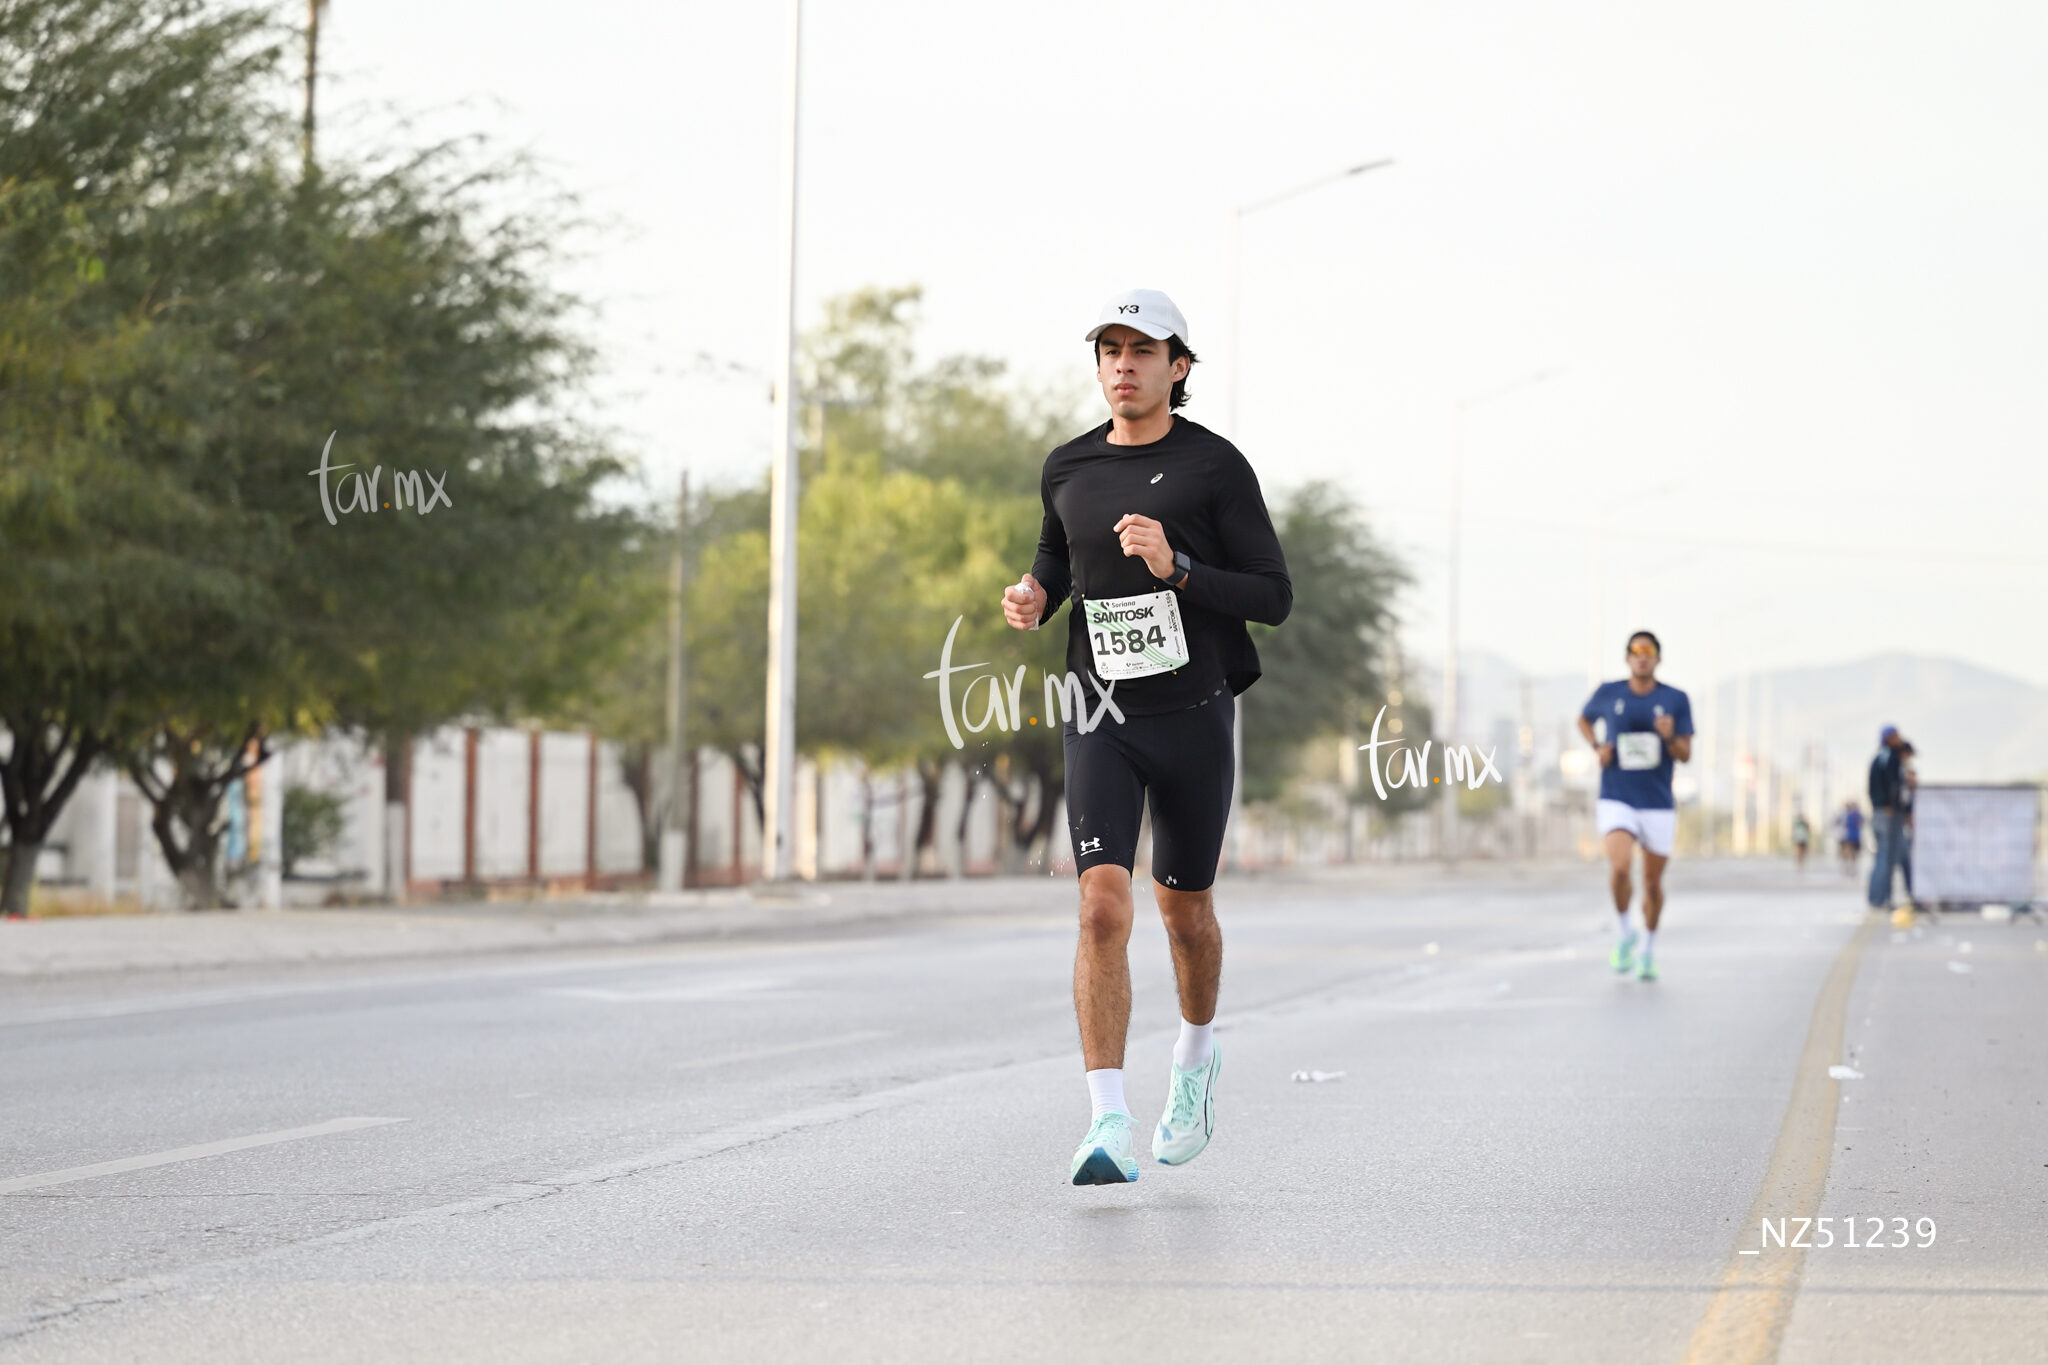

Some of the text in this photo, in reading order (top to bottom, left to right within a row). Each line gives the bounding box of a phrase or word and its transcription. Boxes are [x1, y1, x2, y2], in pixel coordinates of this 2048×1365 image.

[1118, 304, 1140, 314] Y-3
[1111, 600, 1136, 608] Soriana
[1093, 606, 1154, 623] SANTOSK
[1094, 625, 1166, 656] 1584
